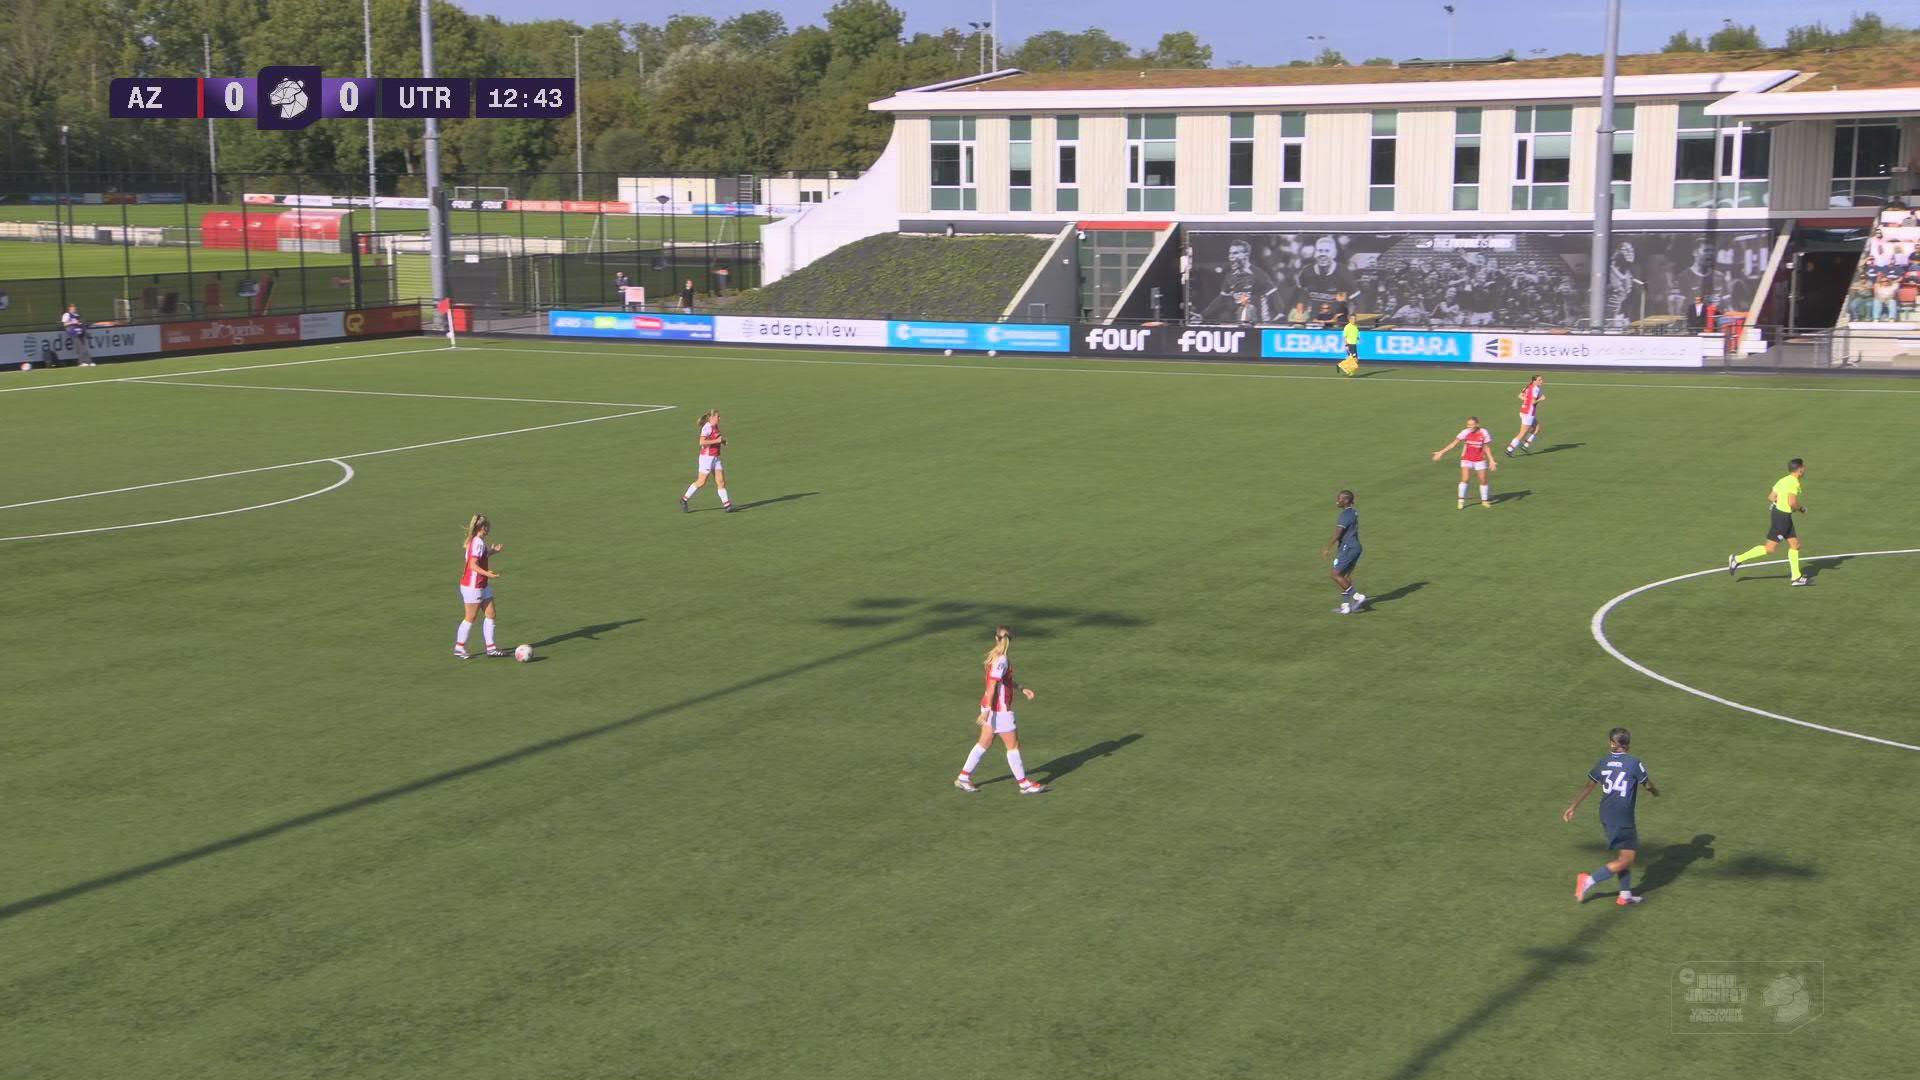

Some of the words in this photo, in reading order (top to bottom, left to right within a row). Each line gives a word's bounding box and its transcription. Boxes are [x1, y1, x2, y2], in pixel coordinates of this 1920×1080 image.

[759, 320, 857, 340] adeptview
[1085, 328, 1152, 351] four
[41, 331, 136, 352] adetview
[1177, 330, 1246, 354] four
[1375, 335, 1460, 356] LEBARA
[1519, 342, 1590, 357] leaseweb
[1601, 769, 1628, 797] 34
